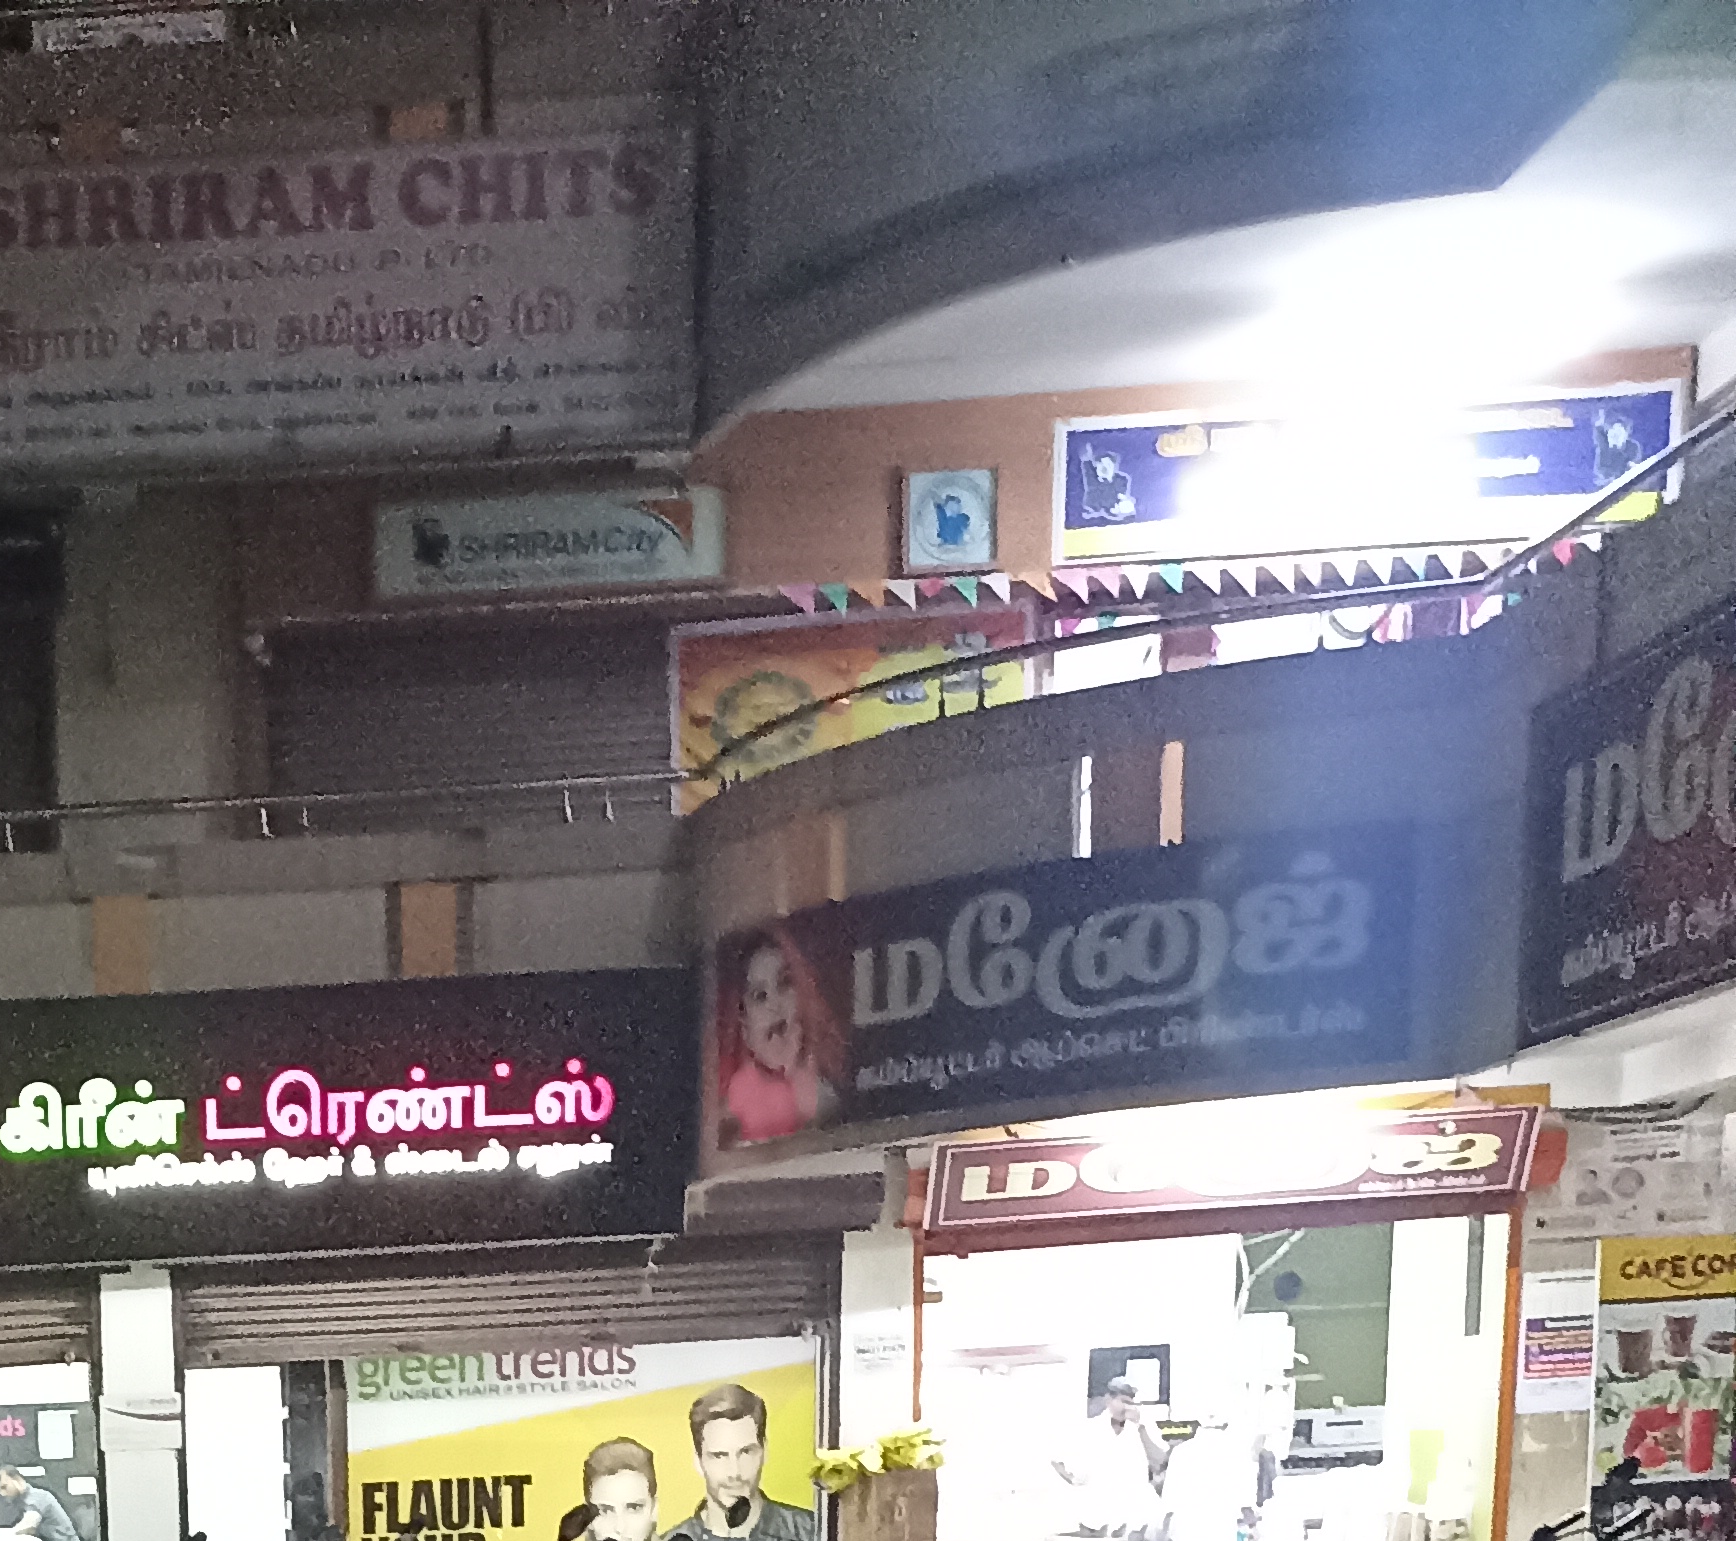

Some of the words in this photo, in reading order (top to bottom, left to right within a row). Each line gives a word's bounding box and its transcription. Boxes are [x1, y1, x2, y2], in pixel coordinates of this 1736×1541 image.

[397, 144, 666, 230] CHITS
[0, 1076, 186, 1155] கிரீன்
[204, 1057, 615, 1146] ட்ரெண்ட்ஸ்
[1619, 1253, 1688, 1281] CAFE
[356, 1349, 484, 1401] green
[493, 1344, 638, 1381] trends
[457, 1383, 501, 1397] HAIR
[361, 1475, 532, 1535] FLAUNT
